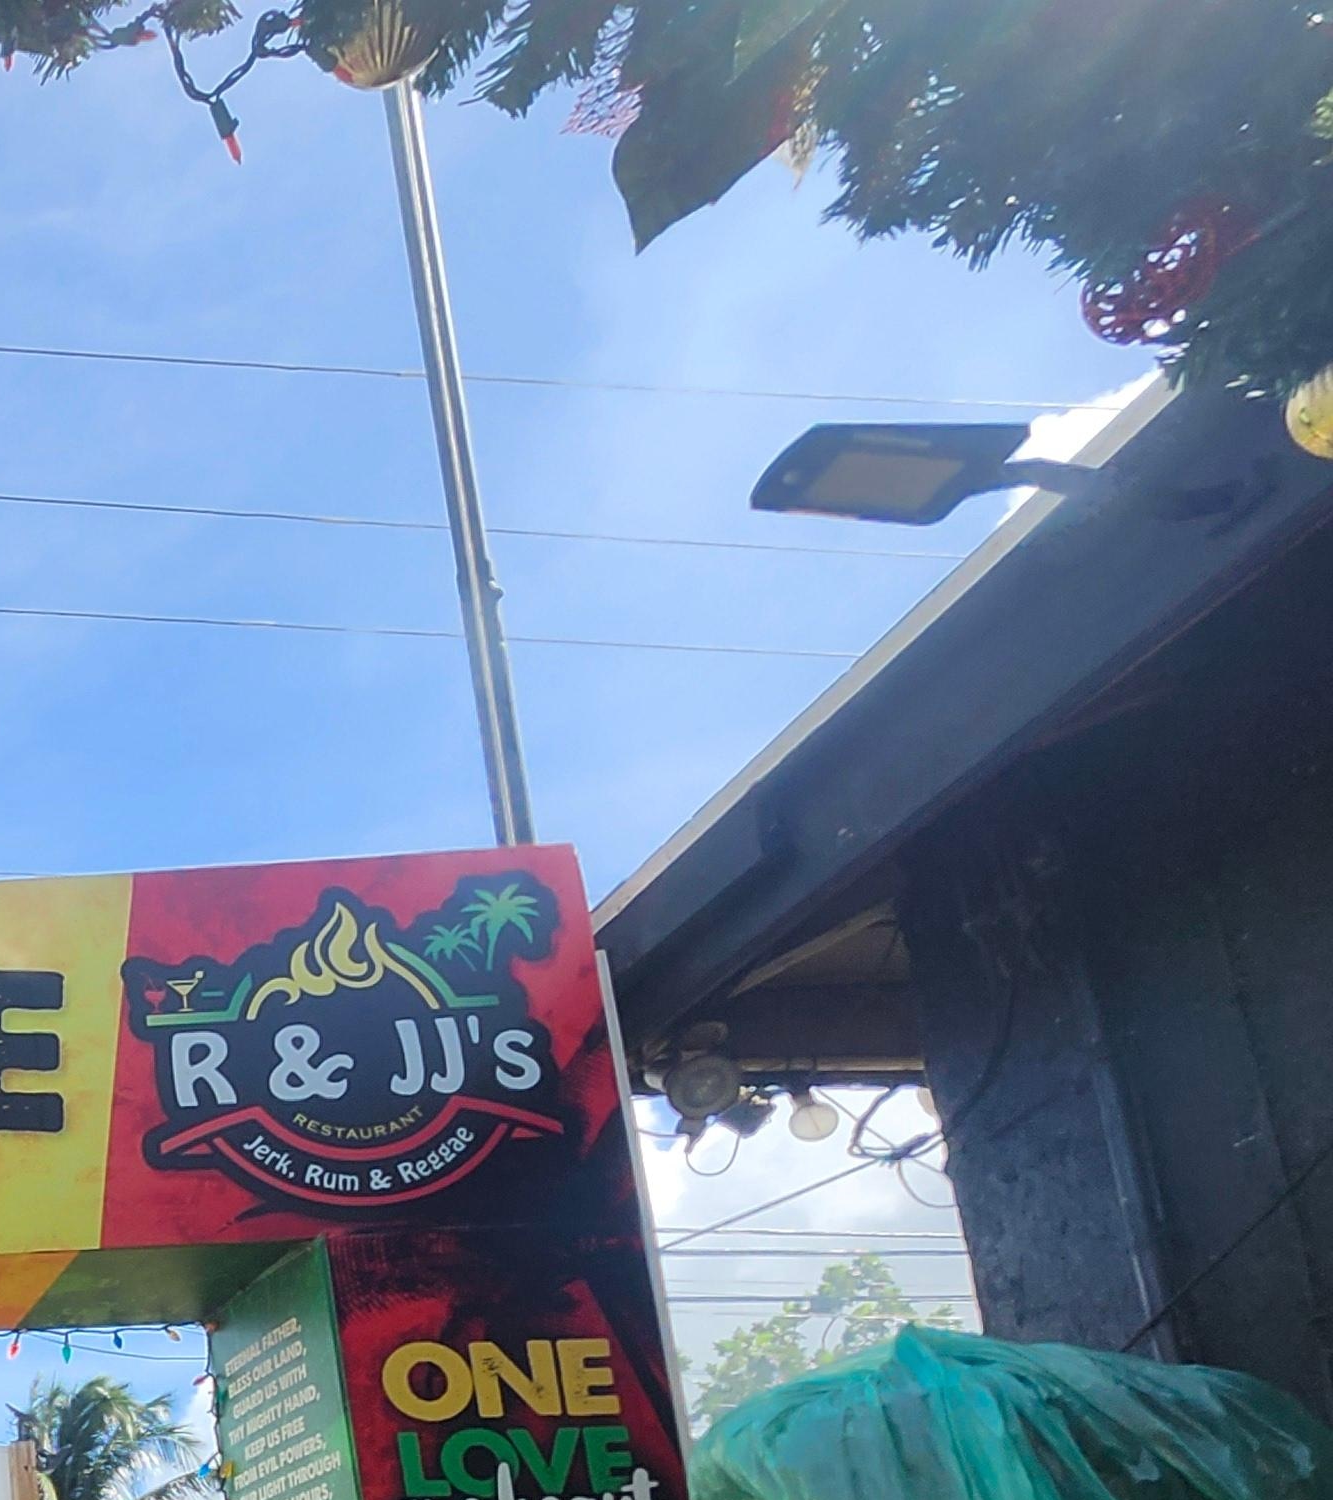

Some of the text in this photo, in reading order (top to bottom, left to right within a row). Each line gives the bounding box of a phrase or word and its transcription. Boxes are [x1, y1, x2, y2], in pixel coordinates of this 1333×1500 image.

[171, 1015, 542, 1108] R & JJ's
[292, 1105, 424, 1140] RESTAURANT
[243, 1124, 476, 1193] Jerk, Rum & Reggae
[251, 1358, 274, 1382] OUR
[273, 1340, 307, 1369] LAND,
[263, 1380, 278, 1400] US
[278, 1363, 308, 1392] WITH
[381, 1337, 622, 1422] ONE
[283, 1384, 321, 1414] HAND,
[266, 1428, 281, 1449] US
[280, 1415, 306, 1441] FREE
[233, 1466, 258, 1491] FROM
[258, 1455, 279, 1479] EVIL
[258, 1476, 286, 1500] LIGHT
[286, 1450, 342, 1488] THROUGH
[397, 1426, 632, 1499] LOVE
